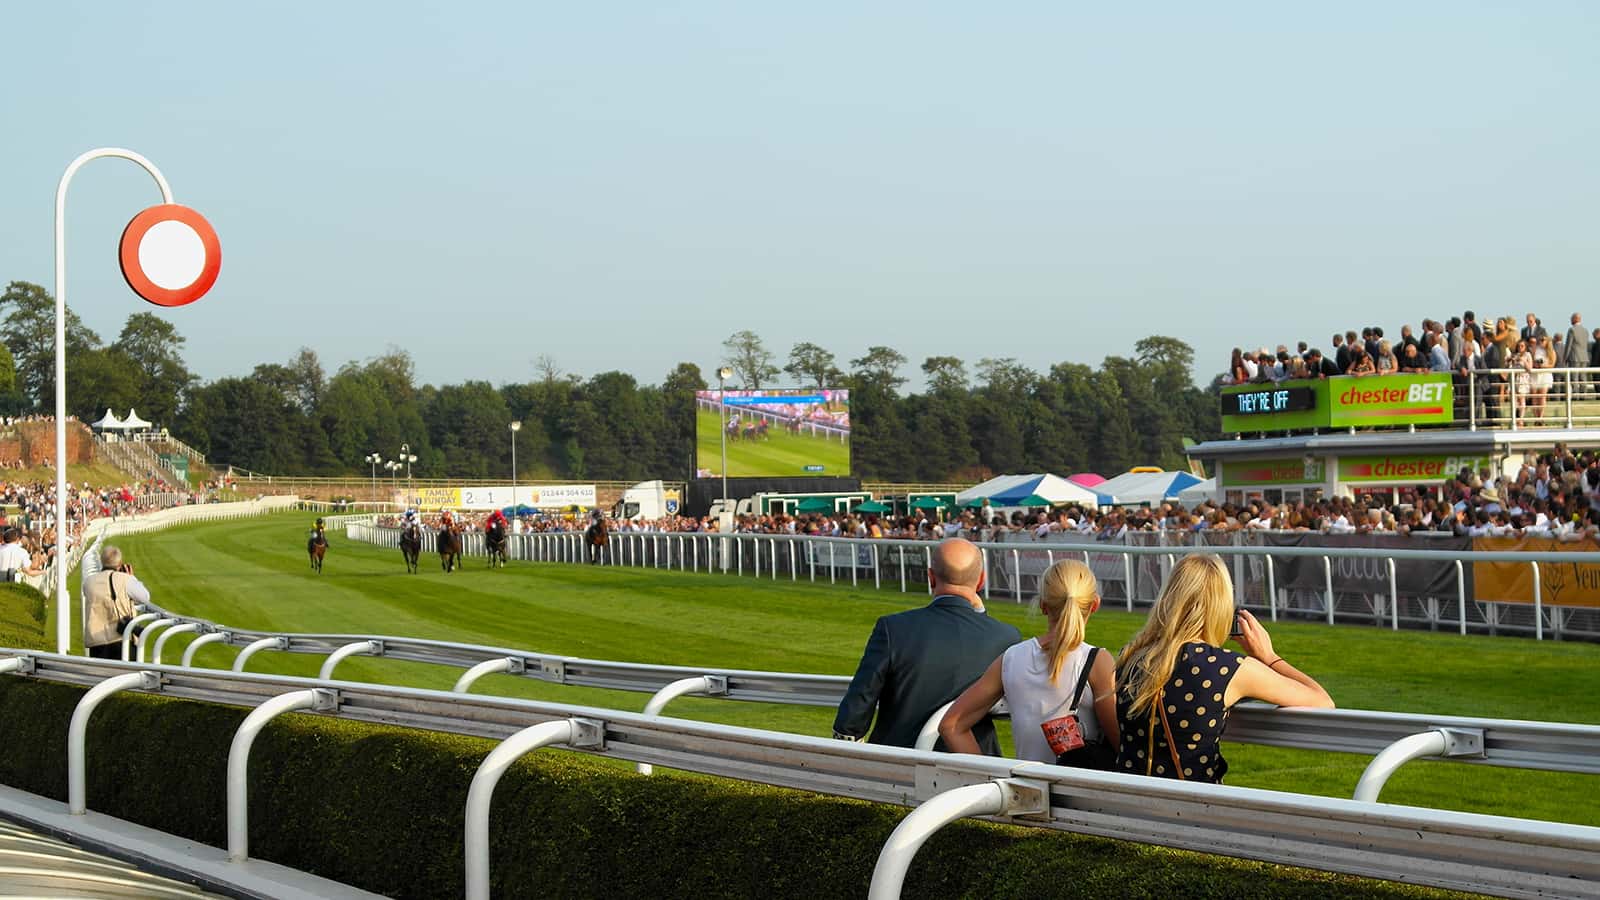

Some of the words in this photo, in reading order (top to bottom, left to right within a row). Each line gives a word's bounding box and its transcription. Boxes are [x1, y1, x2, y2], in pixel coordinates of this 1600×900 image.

[1238, 391, 1271, 412] THEY'RE
[1273, 390, 1289, 409] OFF
[1340, 383, 1447, 405] chesterBET
[425, 489, 455, 497] FAMILY
